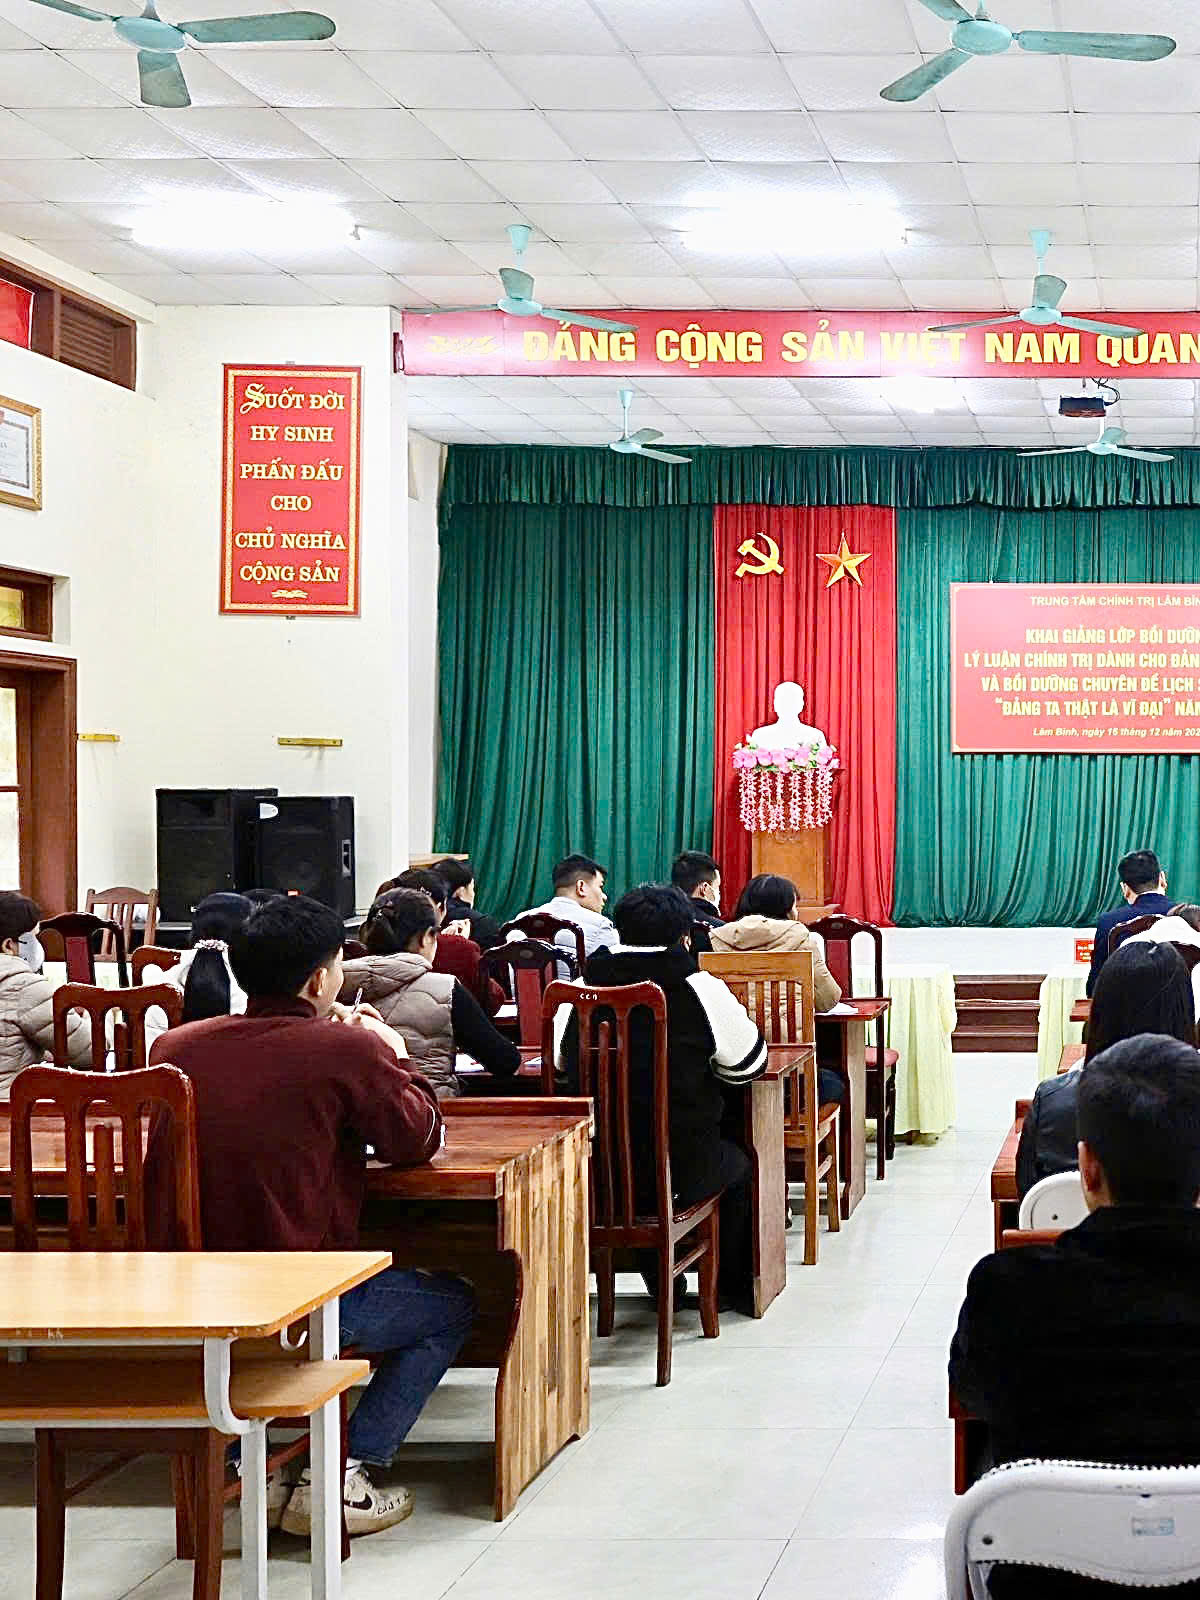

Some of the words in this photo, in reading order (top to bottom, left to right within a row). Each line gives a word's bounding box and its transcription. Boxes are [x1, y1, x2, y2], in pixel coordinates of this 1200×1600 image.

[523, 319, 637, 362] ĐẢNG
[655, 324, 763, 369] CỘNG
[781, 319, 865, 363] SẢN
[879, 325, 967, 369] VIỆT
[984, 332, 1080, 363] NAM
[239, 383, 305, 415] SUỐT
[308, 389, 345, 410] ĐỜI
[250, 425, 280, 442] HY
[283, 426, 334, 443] SINH
[239, 457, 297, 481] PHẤN
[300, 457, 344, 481] ĐẤU
[270, 495, 312, 512] CHO
[235, 526, 277, 549] CHỦ
[280, 531, 346, 550] NGHĨA
[239, 561, 296, 585] CỘNG
[299, 559, 341, 583] SẢN
[1030, 596, 1069, 606] TRUNG
[1071, 595, 1096, 606] TÂM
[1098, 594, 1135, 606] CHÍNH
[1136, 596, 1156, 608] TRỊ
[1157, 594, 1181, 606] LÂM
[1025, 628, 1059, 644] KHAI
[1062, 624, 1106, 644] GIẢNG
[1109, 625, 1136, 644] LỚP
[964, 650, 981, 668] LÝ
[983, 650, 1021, 671] LUẬN
[1024, 650, 1068, 669] CHÍNH
[1070, 652, 1093, 671] TRỊ
[1096, 649, 1136, 669] DÀNH
[1138, 652, 1167, 669] CHO
[980, 673, 1000, 692] VÀ
[1030, 673, 1079, 692] DƯỠNG
[1081, 673, 1138, 692] CHUYÊN
[1162, 677, 1195, 696] LỊCH
[1043, 700, 1061, 716] TA
[1063, 698, 1099, 719] THẬT
[1101, 698, 1119, 716] LÀ
[1107, 727, 1119, 737] 16
[1120, 727, 1147, 739] tháng
[1150, 727, 1161, 737] 12
